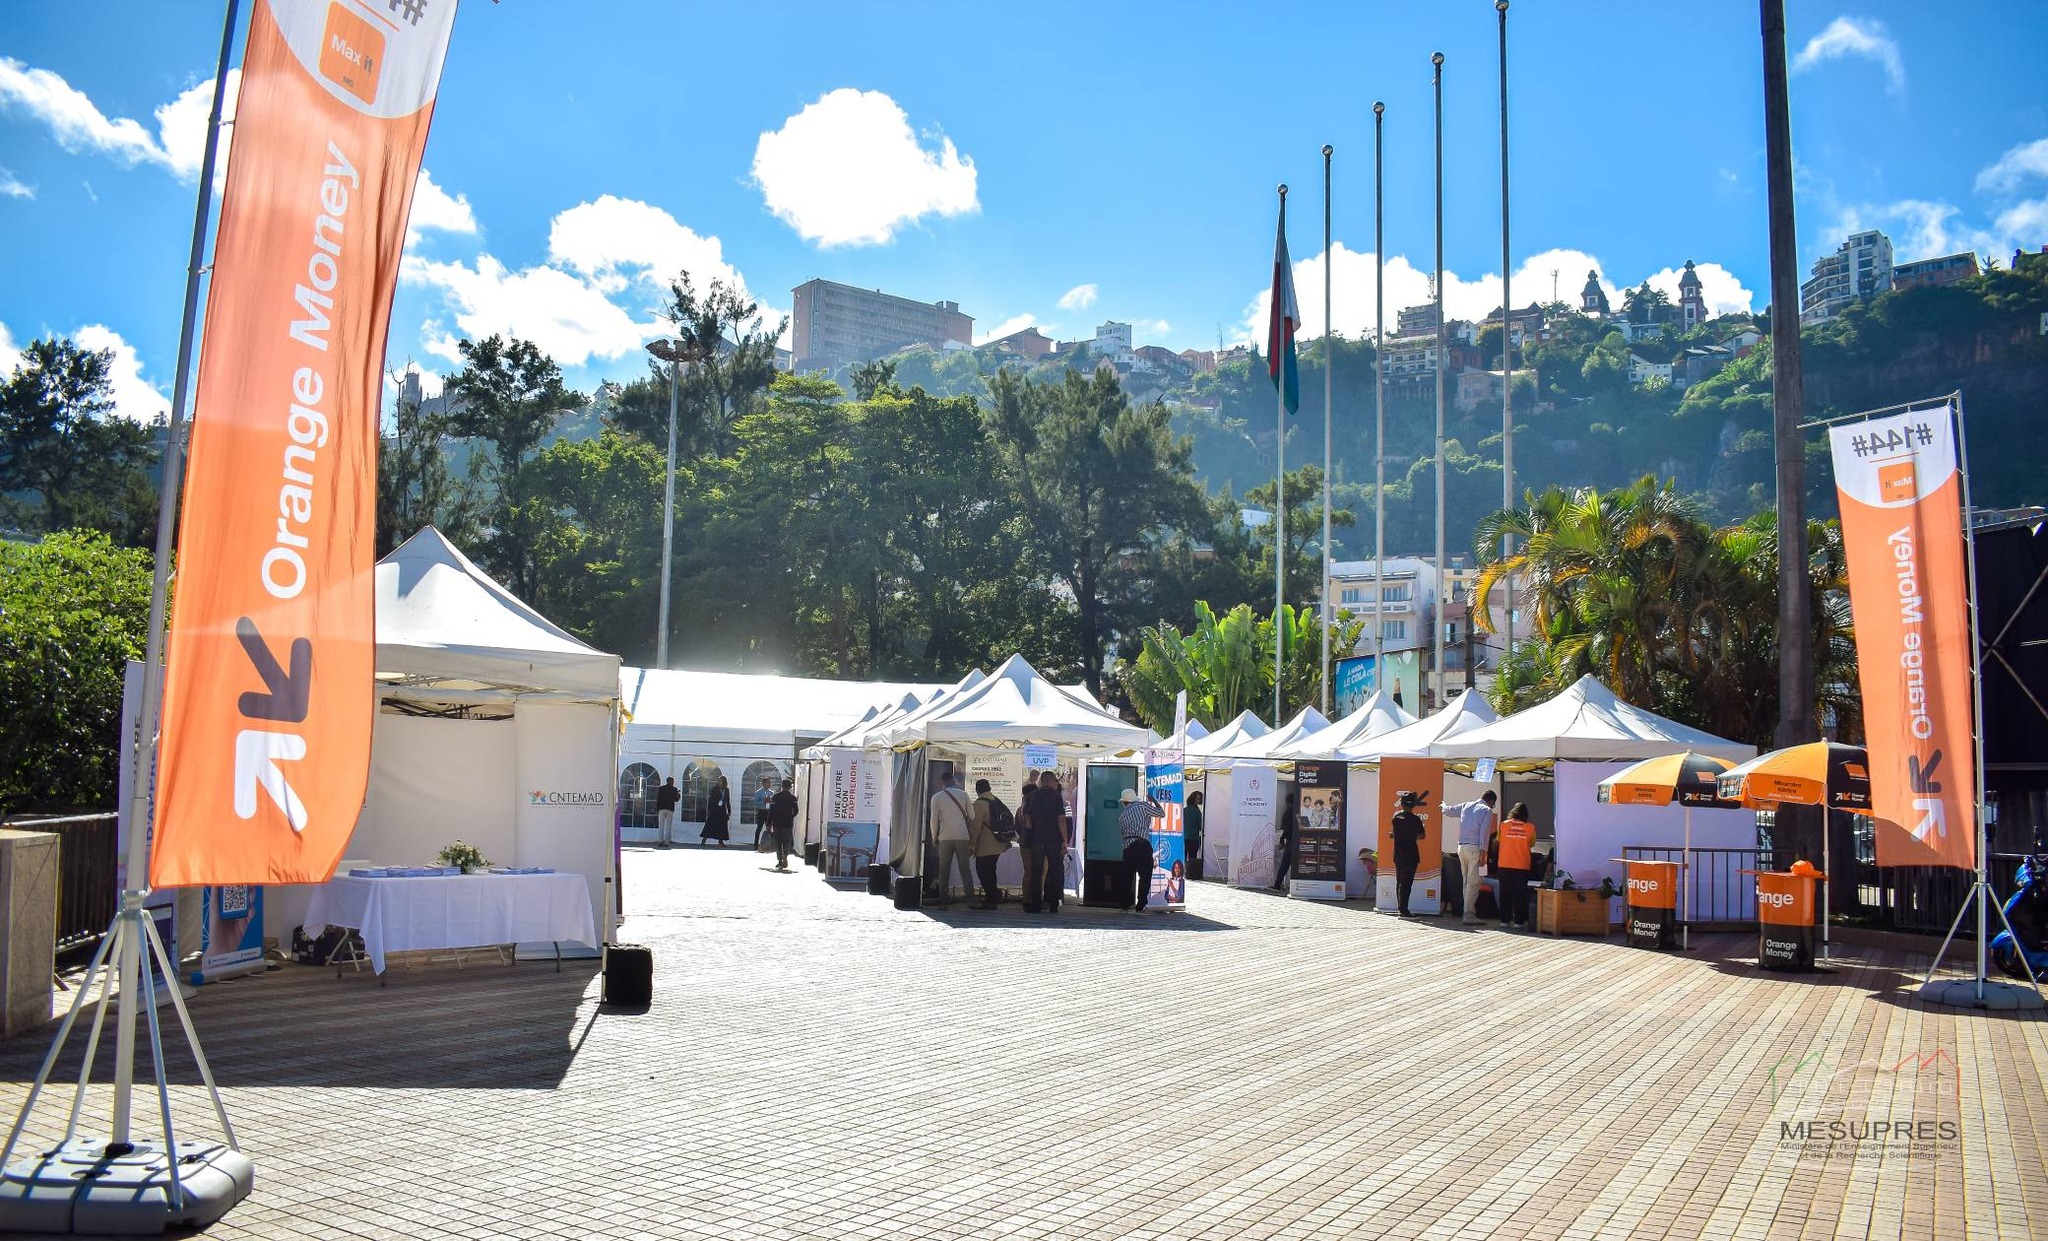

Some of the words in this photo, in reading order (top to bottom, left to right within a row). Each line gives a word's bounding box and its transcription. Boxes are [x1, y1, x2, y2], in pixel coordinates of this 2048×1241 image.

[331, 34, 361, 65] Max
[363, 55, 373, 74] it
[288, 139, 360, 352] Money
[261, 366, 329, 600] Orange
[1033, 757, 1050, 765] UVP
[835, 770, 843, 799] AUTRE
[1147, 773, 1183, 788] CNTEMAD
[848, 759, 858, 819] D'APPRENDRE
[549, 791, 604, 803] CNTEMAD
[841, 790, 849, 819] FAÇON
[1633, 920, 1661, 931] Orange
[1633, 928, 1658, 939] Money
[1765, 939, 1797, 950] Orange
[1765, 947, 1794, 960] Money
